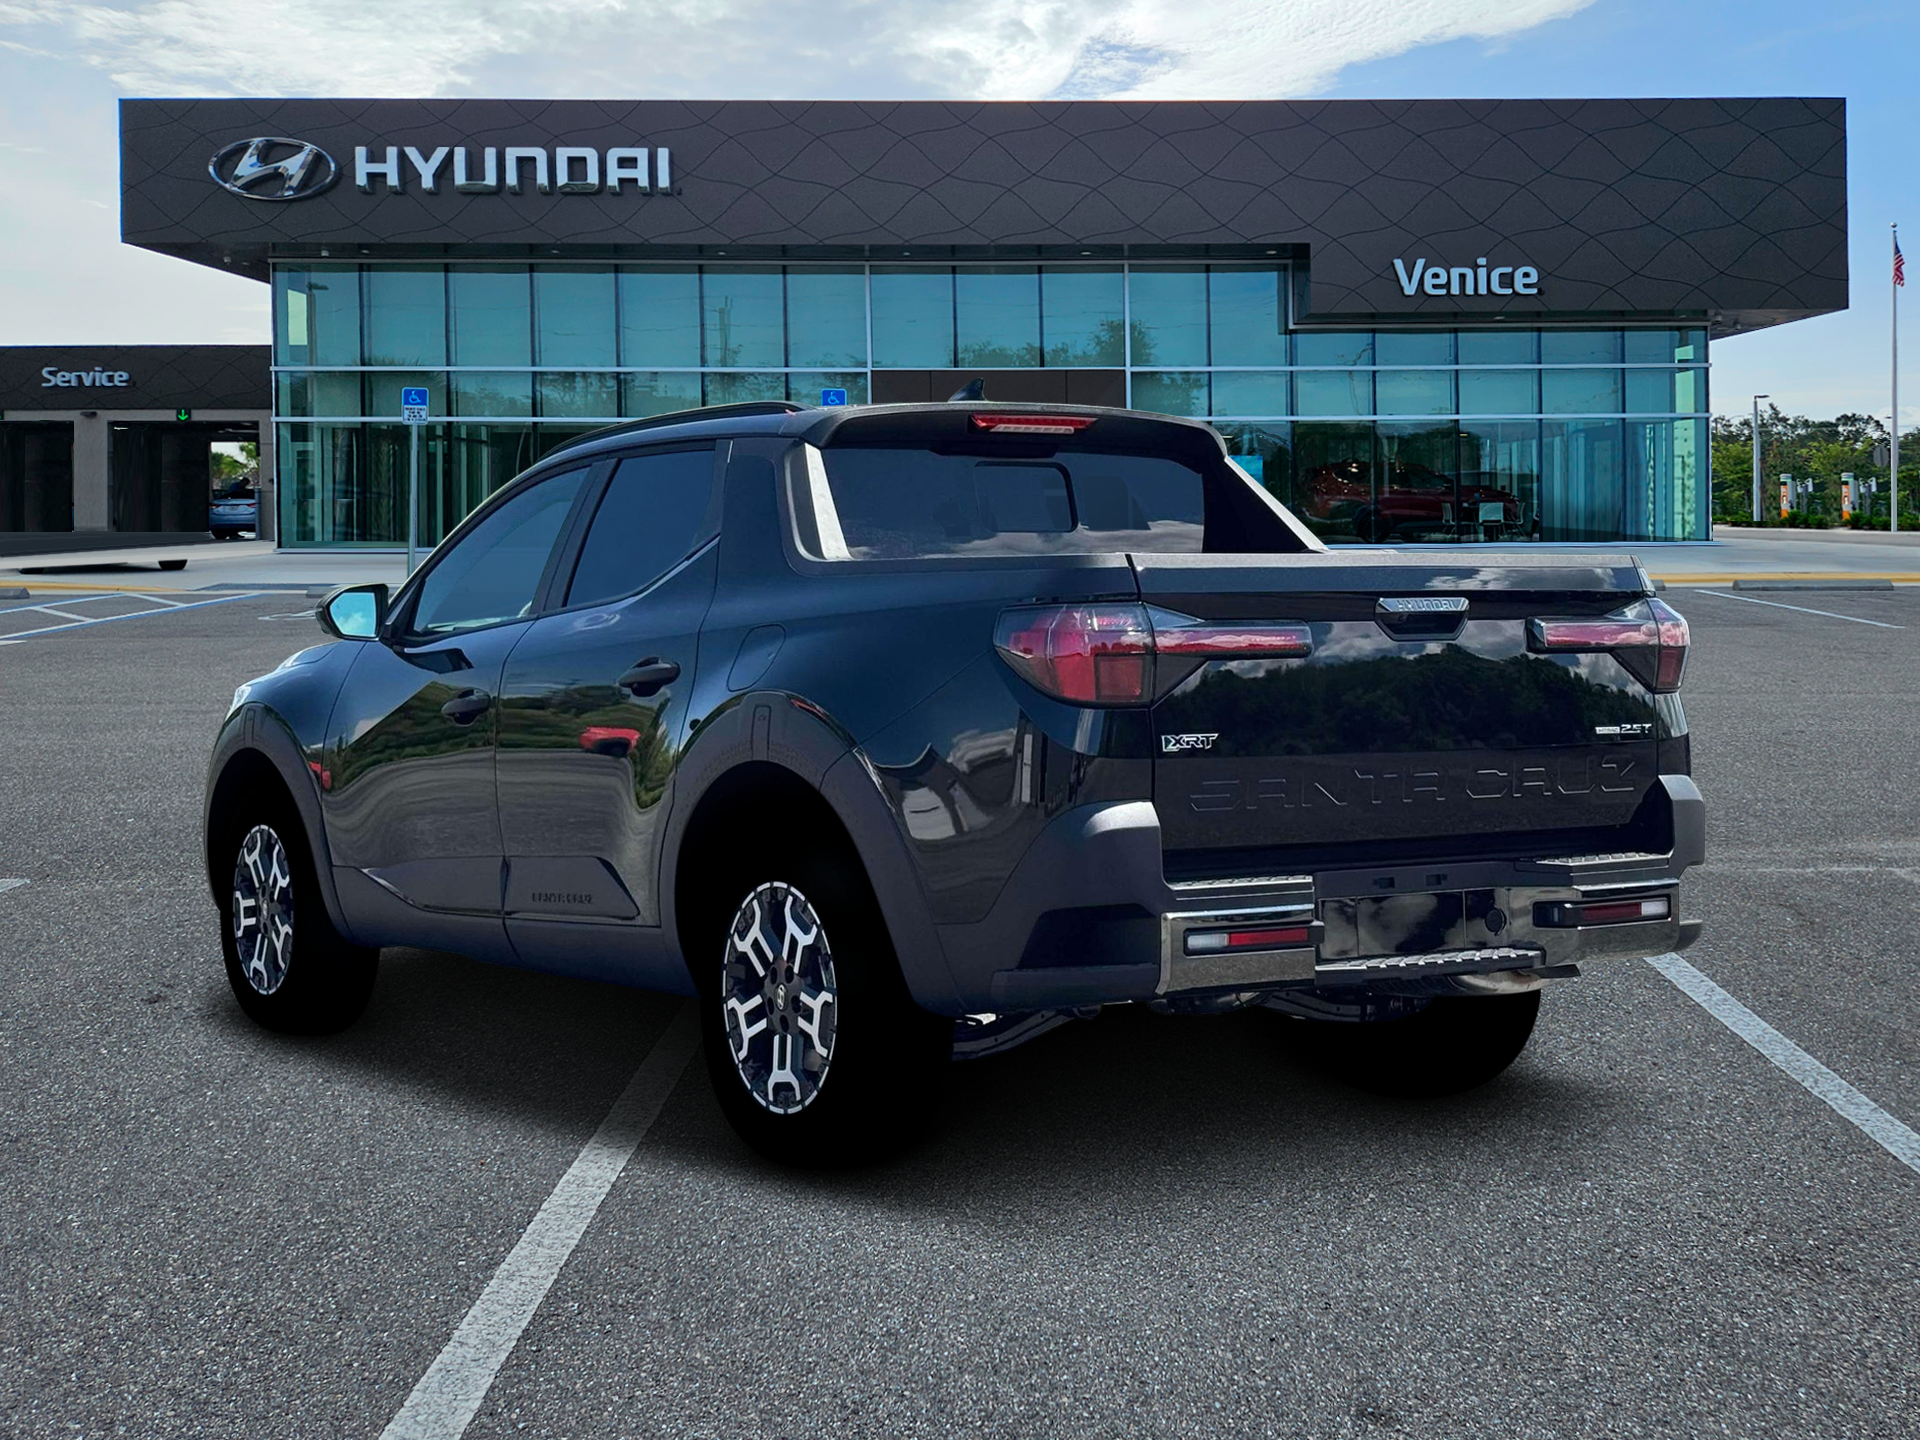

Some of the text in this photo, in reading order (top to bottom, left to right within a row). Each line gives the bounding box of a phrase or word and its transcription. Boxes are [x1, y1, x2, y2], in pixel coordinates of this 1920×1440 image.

[354, 146, 670, 194] HYUNDAI
[1392, 257, 1540, 296] Venice
[41, 366, 130, 387] Service
[1396, 599, 1457, 612] HYUNDAI
[1164, 733, 1219, 751] XRT
[1189, 754, 1637, 811] SANTA CRUZ
